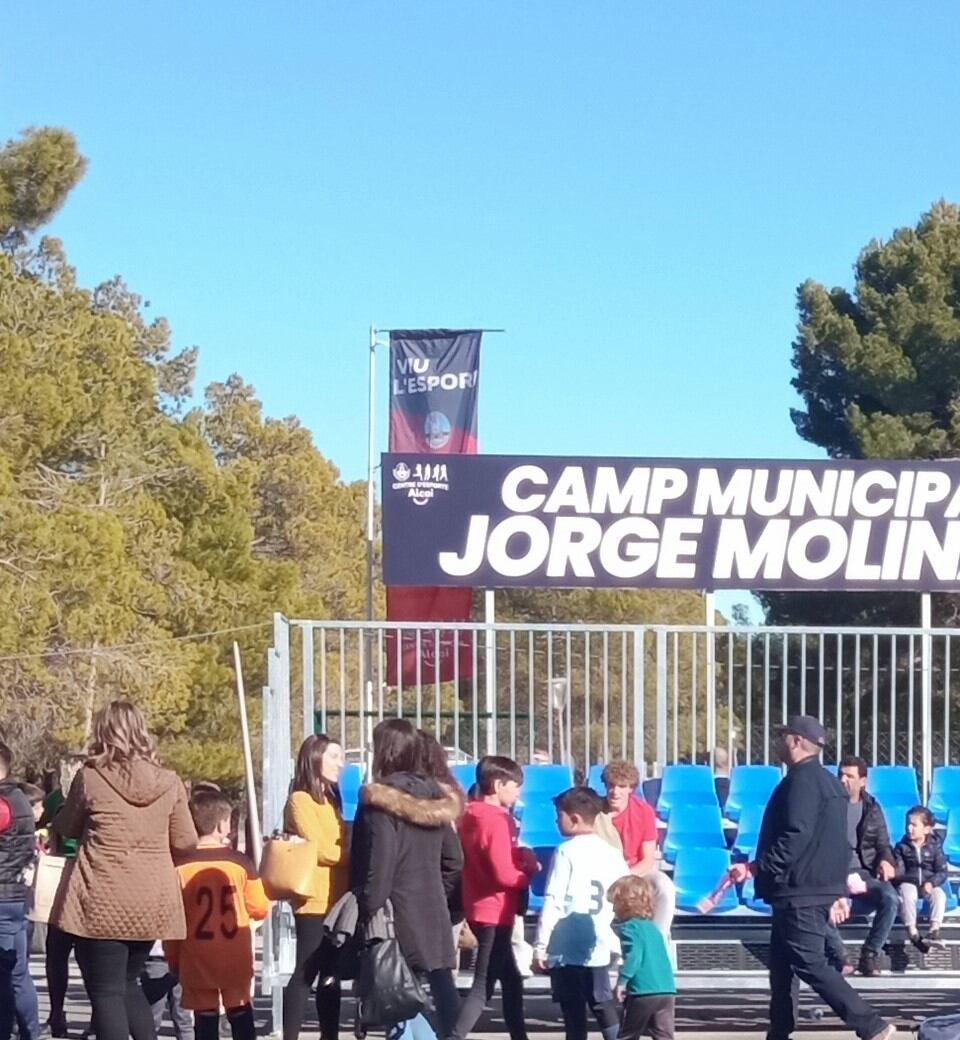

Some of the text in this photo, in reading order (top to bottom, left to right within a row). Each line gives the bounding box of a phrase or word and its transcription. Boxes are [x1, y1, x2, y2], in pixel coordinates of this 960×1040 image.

[397, 358, 430, 375] VIU
[407, 487, 434, 498] Alcoi
[501, 464, 688, 515] CAMP
[438, 514, 704, 579] JORGE
[195, 885, 239, 940] 25
